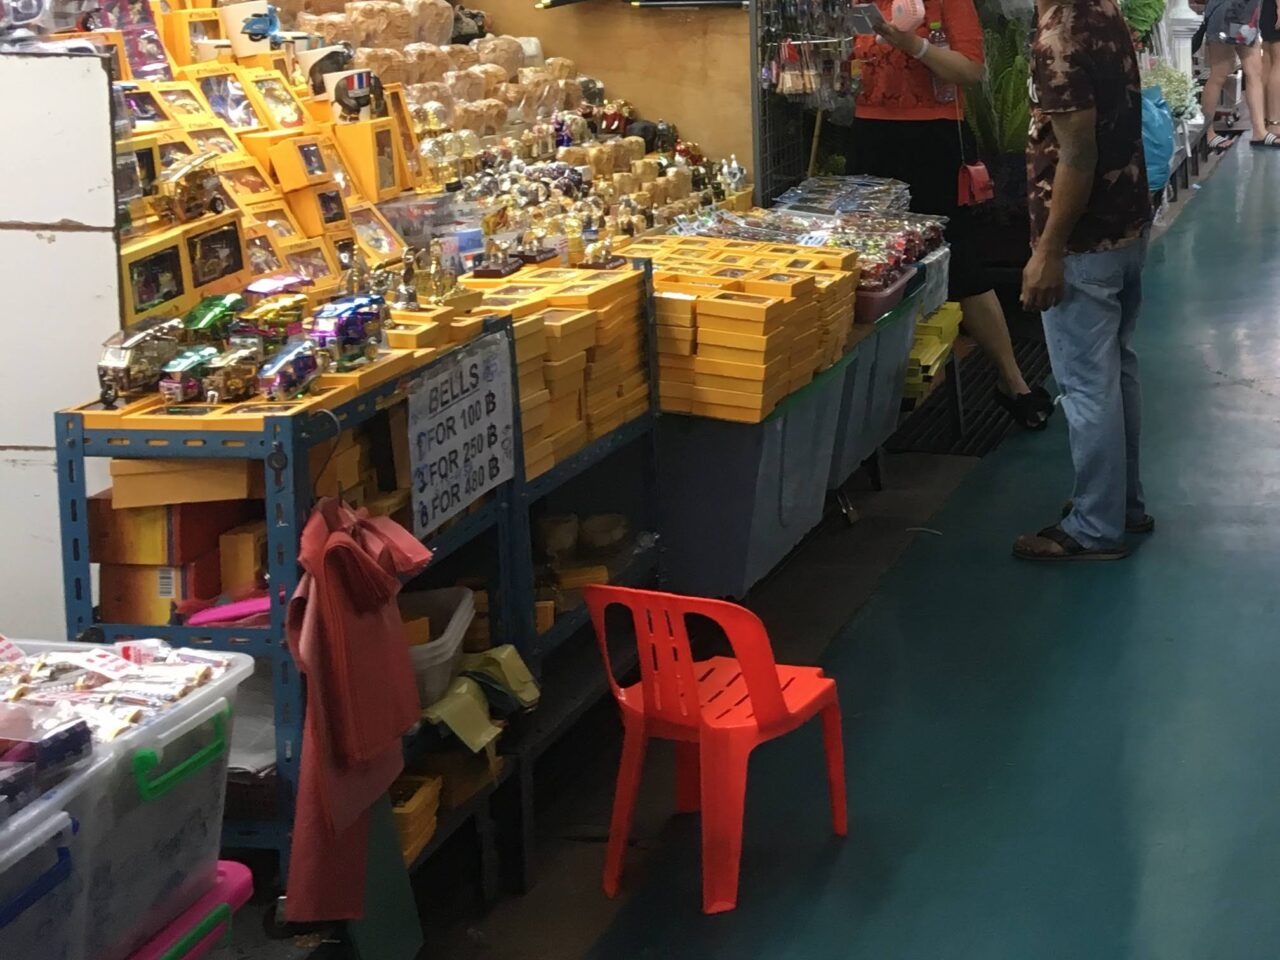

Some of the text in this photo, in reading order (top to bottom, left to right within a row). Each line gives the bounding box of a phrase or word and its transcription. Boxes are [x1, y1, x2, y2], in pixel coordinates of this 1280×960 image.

[428, 363, 480, 414] BELLS
[428, 416, 457, 452] FOR
[460, 400, 482, 430] 100
[429, 449, 459, 486] FOR
[463, 433, 484, 464] 250
[432, 483, 461, 520] FOR
